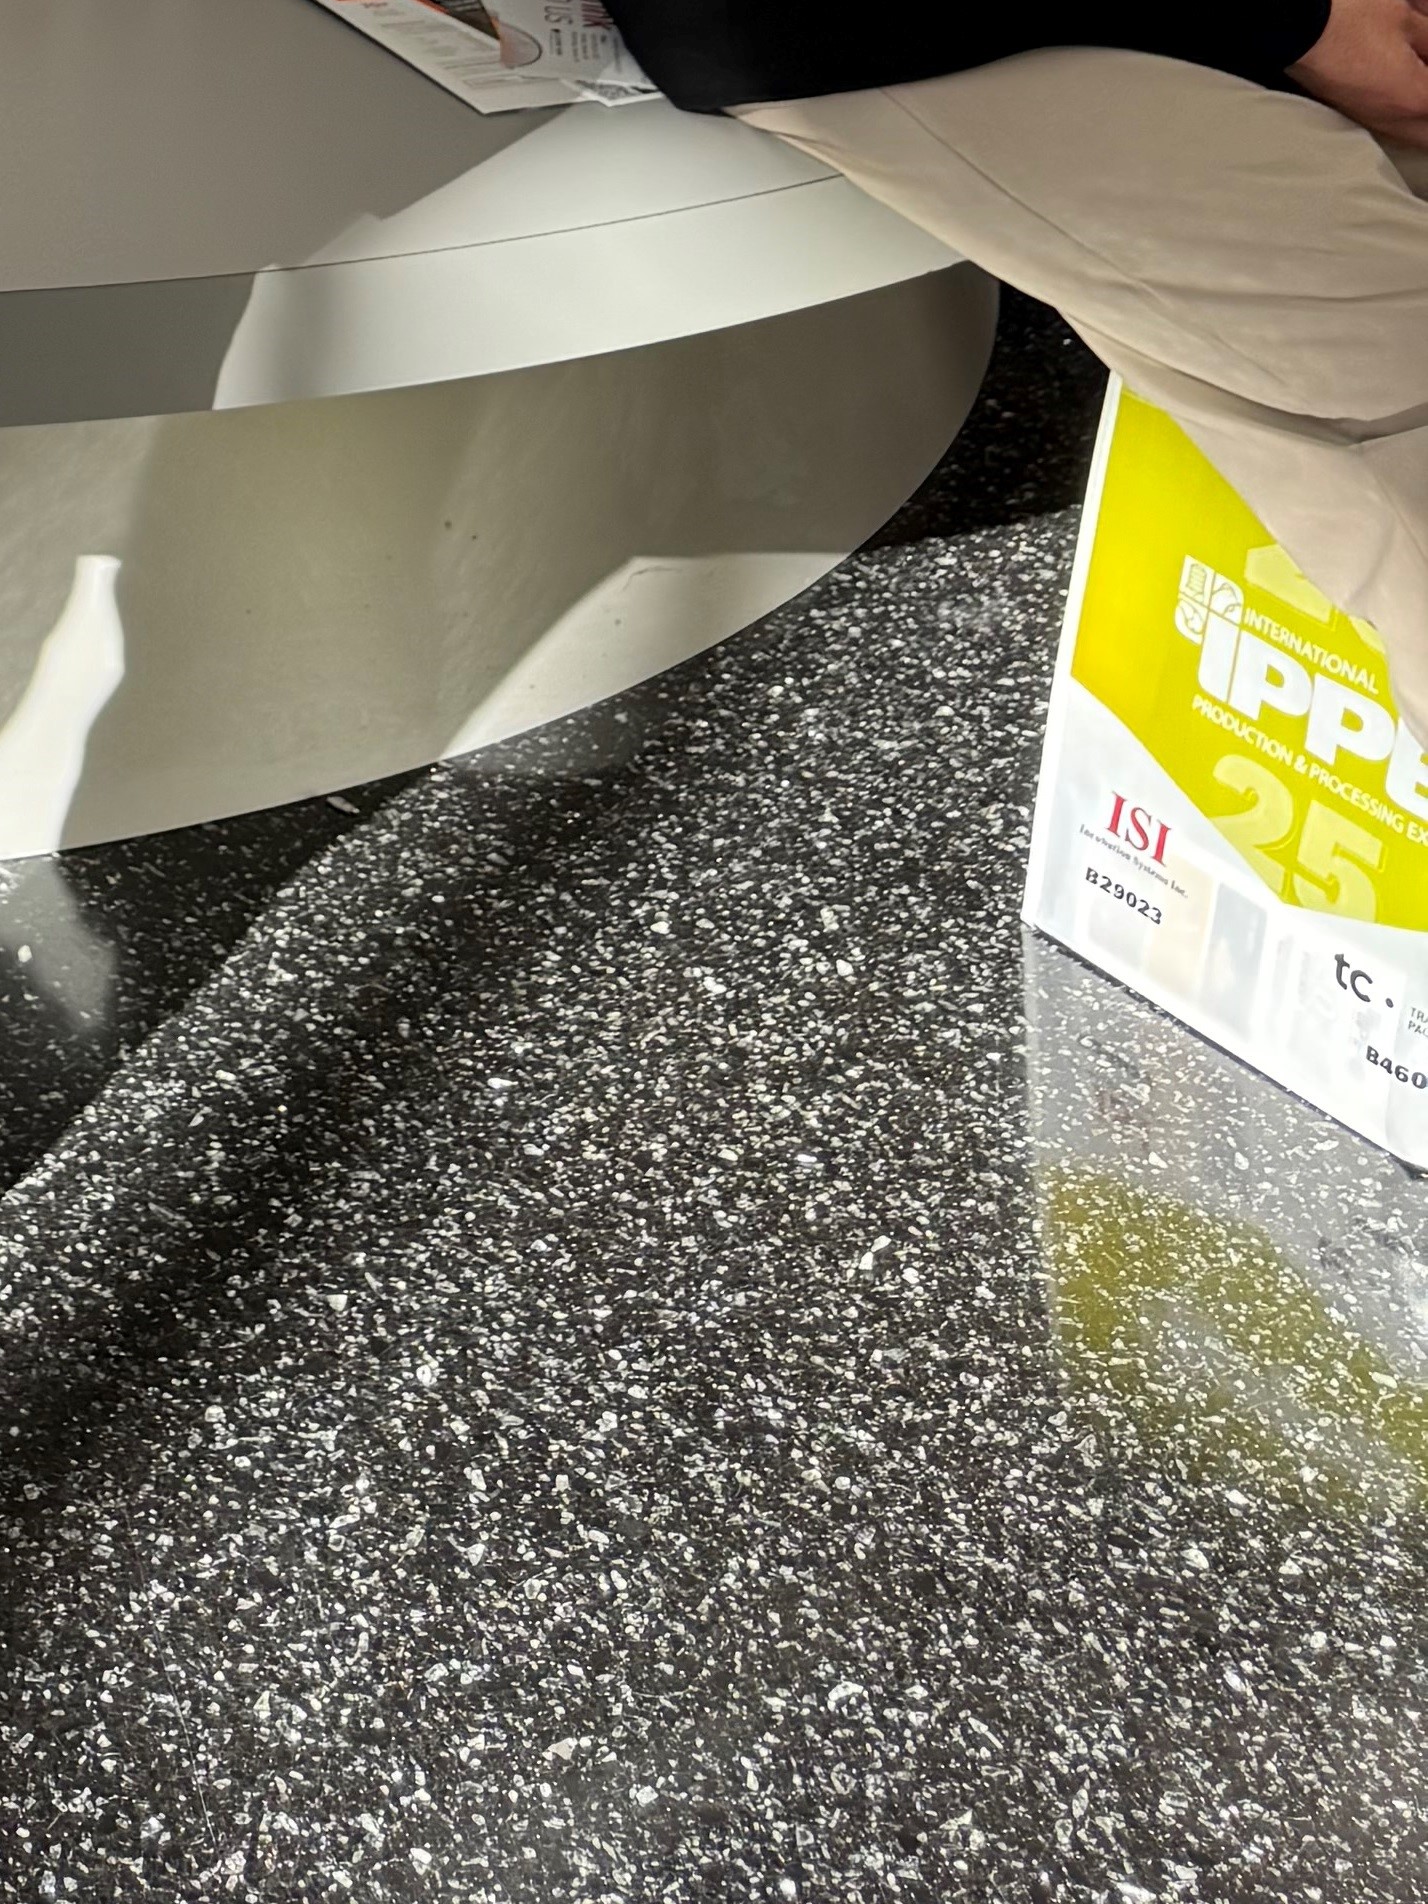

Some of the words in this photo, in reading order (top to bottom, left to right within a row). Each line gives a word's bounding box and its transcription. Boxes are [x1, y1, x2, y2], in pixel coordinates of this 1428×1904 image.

[1244, 605, 1380, 695] INTERNATIONAL
[1191, 695, 1294, 768] PRODUCTION
[1296, 753, 1308, 776] &
[1309, 760, 1404, 834] PROCESSING
[1105, 791, 1172, 868] ISI
[1084, 866, 1163, 925] B29023
